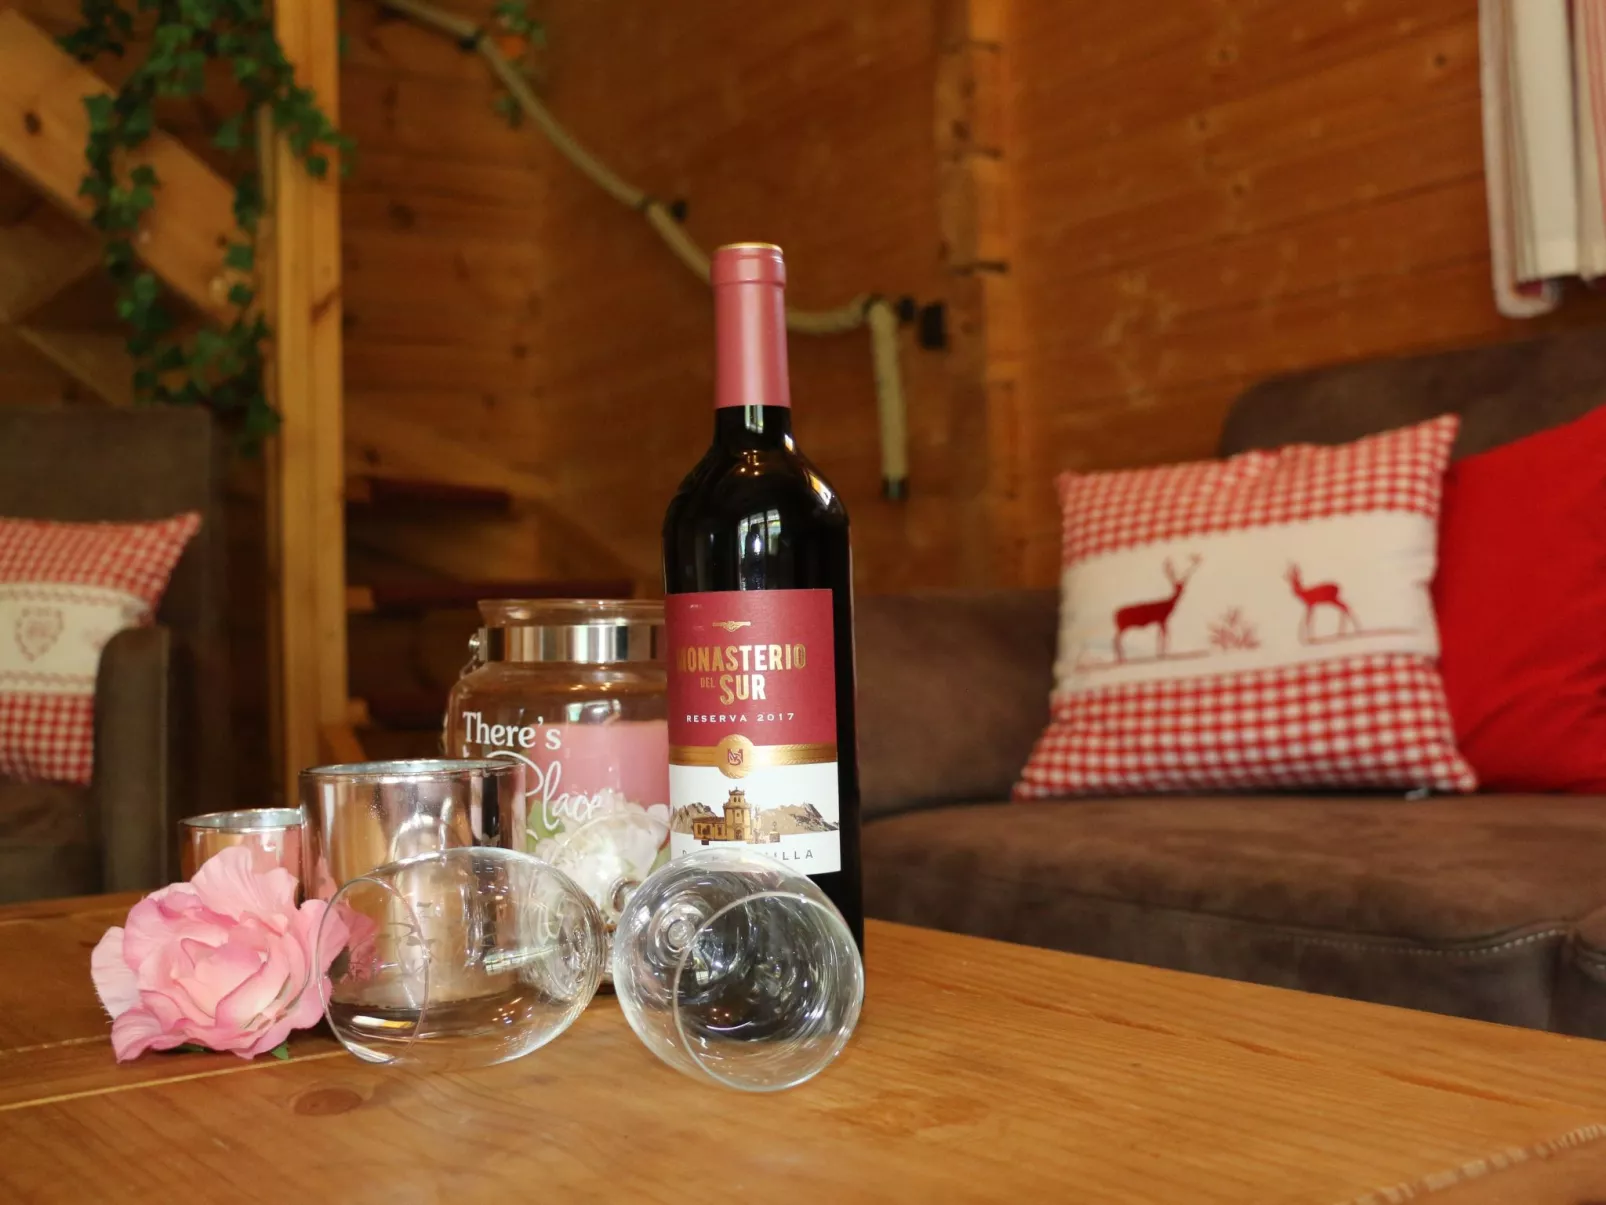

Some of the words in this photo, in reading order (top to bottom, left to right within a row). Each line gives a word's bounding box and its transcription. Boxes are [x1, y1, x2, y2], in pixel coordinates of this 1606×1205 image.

[677, 643, 806, 673] MONASTERIO
[700, 677, 715, 688] DEL
[719, 674, 767, 706] SUR
[462, 711, 562, 750] There's
[686, 714, 748, 723] RESERVA
[756, 712, 795, 722] 2017
